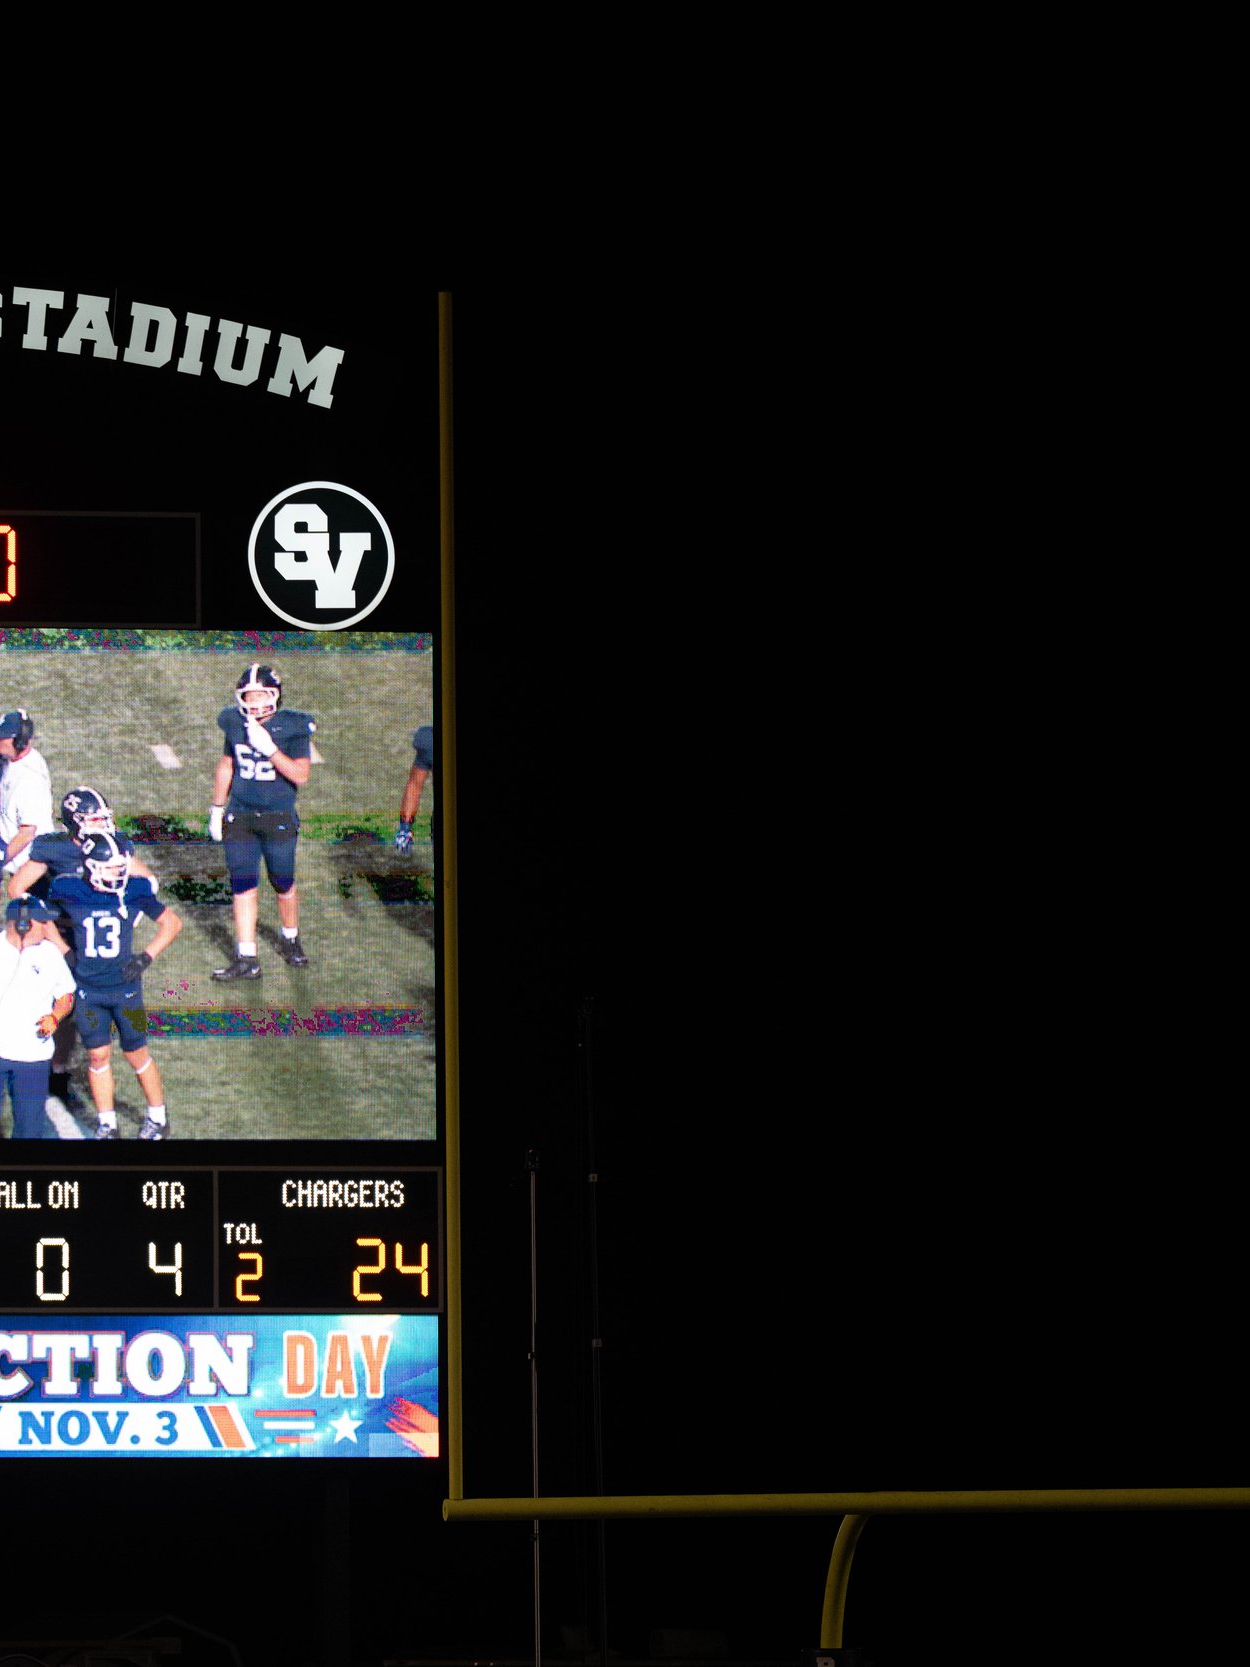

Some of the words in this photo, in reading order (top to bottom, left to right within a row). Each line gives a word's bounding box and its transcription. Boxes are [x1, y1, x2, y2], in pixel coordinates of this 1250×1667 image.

[274, 504, 371, 609] SV
[83, 916, 121, 958] 13
[48, 1181, 79, 1209] ON
[142, 1181, 185, 1209] QTR
[282, 1180, 405, 1207] CHARGERS
[224, 1223, 263, 1244] TOL
[36, 1238, 70, 1301] 0
[149, 1242, 183, 1297] 4
[236, 1252, 263, 1302] 2
[353, 1238, 428, 1302] 24
[283, 1332, 392, 1398] DAY
[18, 1411, 141, 1445] NOV.
[155, 1411, 178, 1445] 3
